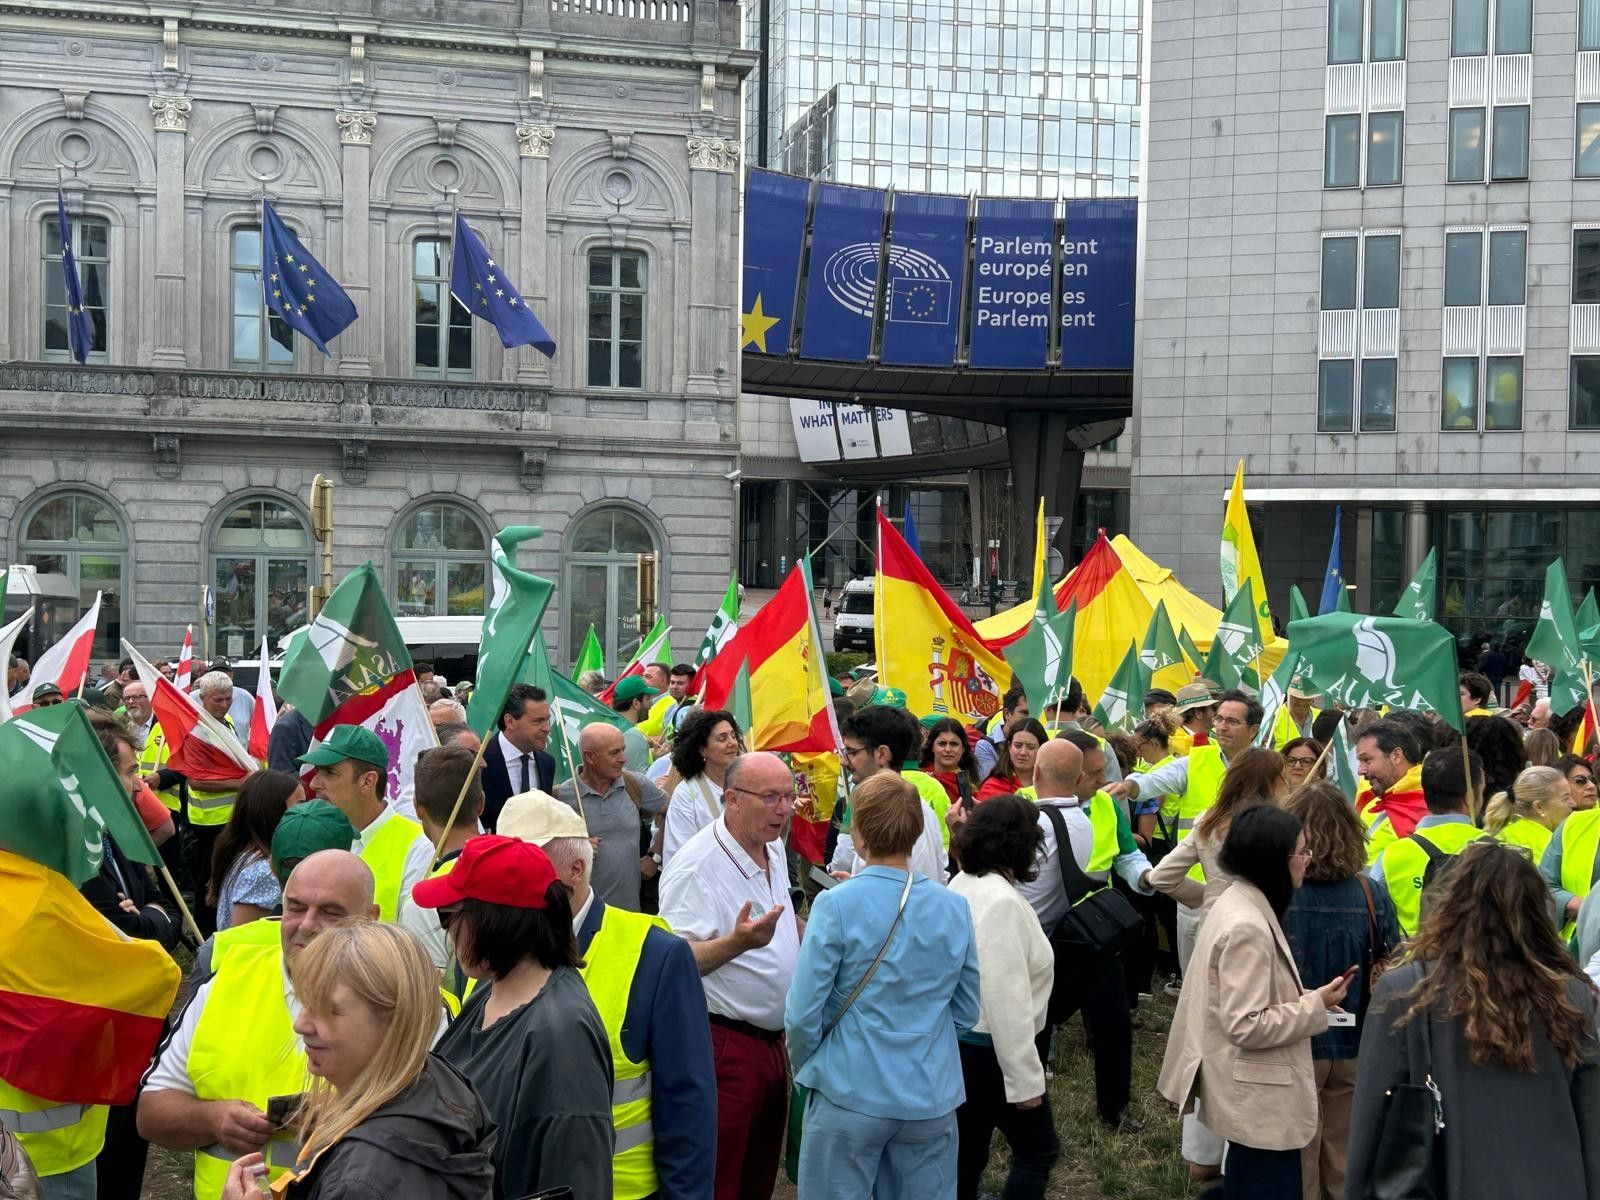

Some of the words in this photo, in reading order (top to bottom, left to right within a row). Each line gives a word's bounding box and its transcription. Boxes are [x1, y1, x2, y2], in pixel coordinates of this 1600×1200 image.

[980, 236, 1098, 255] Parlement
[979, 258, 1088, 280] européen
[978, 286, 1086, 308] Europees
[977, 308, 1096, 327] Parlement
[799, 413, 834, 429] WHAT
[841, 408, 894, 425] MATTERS
